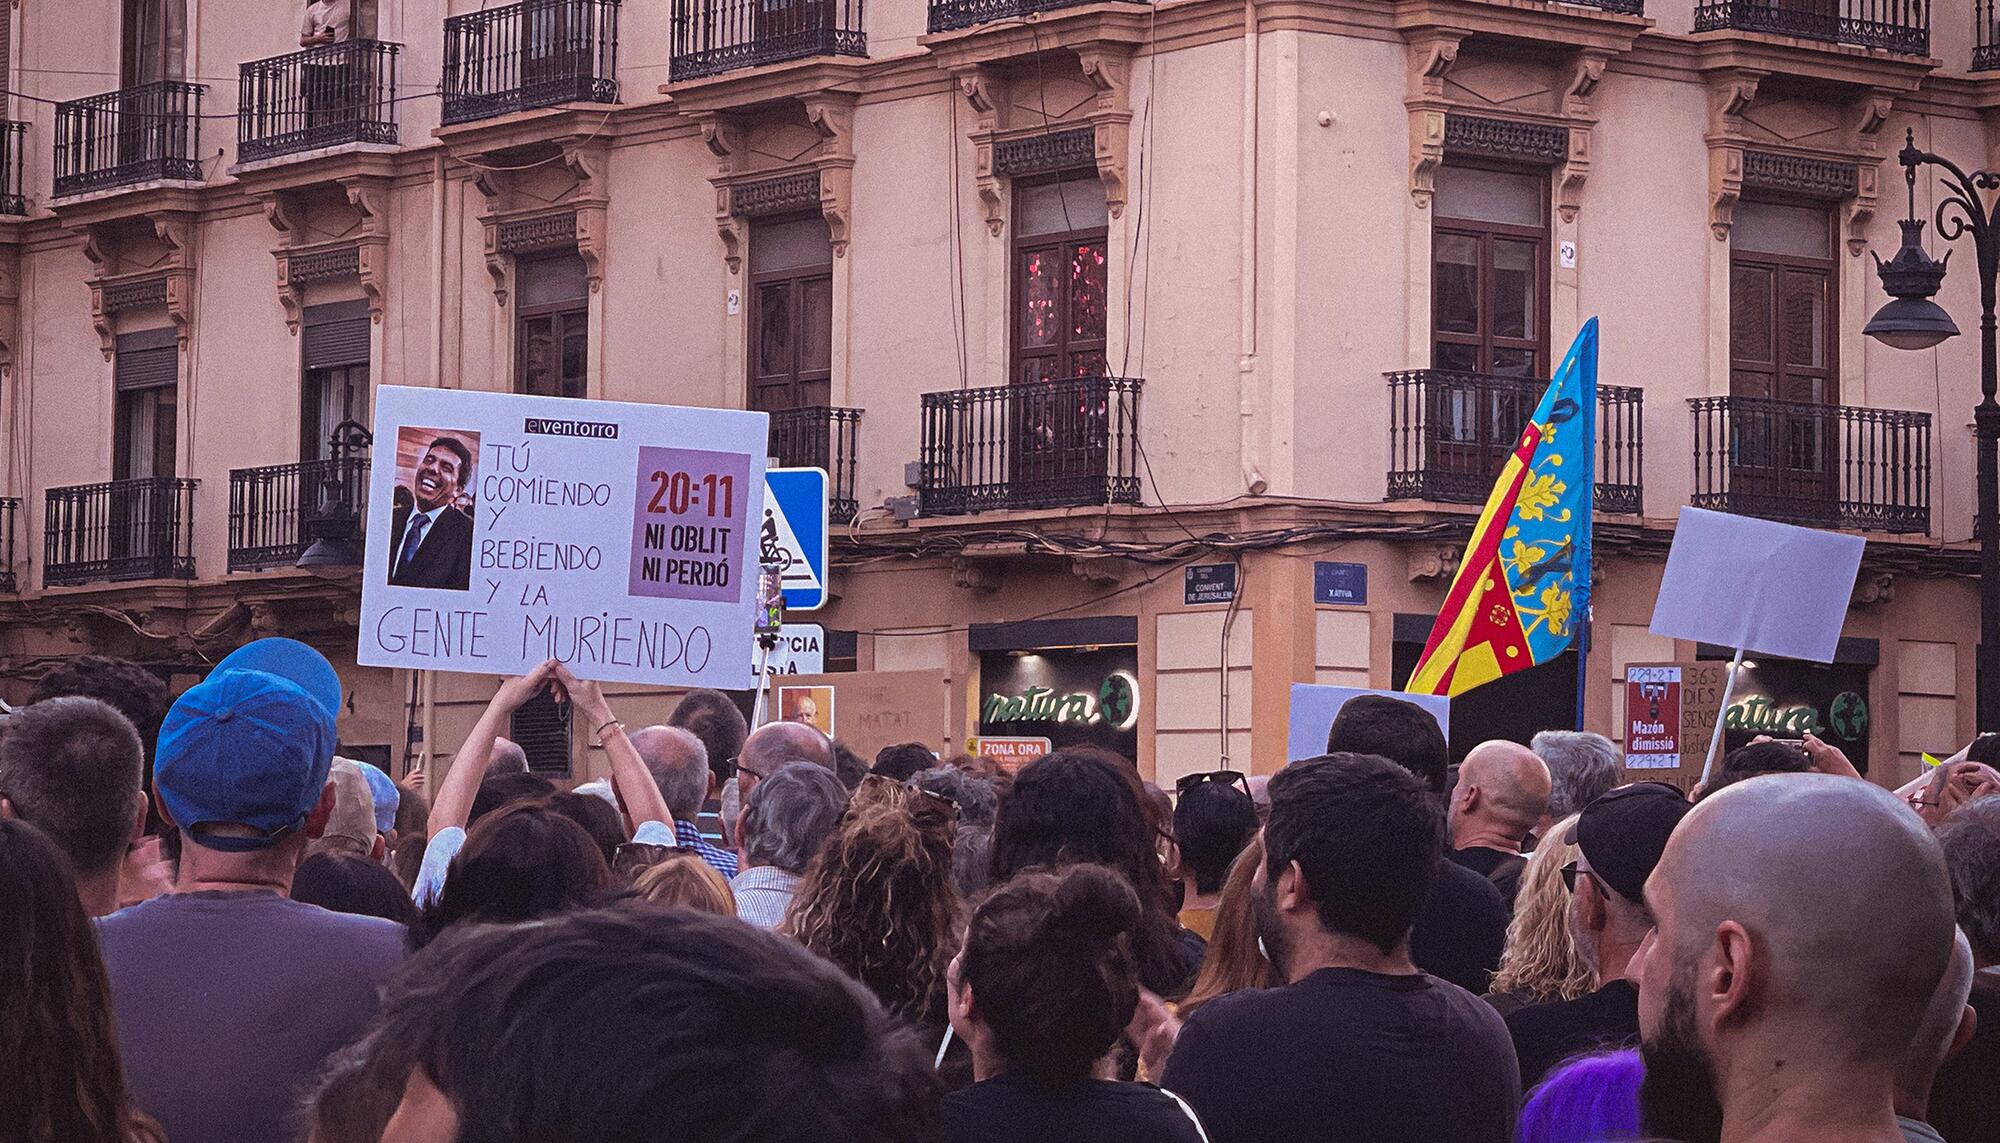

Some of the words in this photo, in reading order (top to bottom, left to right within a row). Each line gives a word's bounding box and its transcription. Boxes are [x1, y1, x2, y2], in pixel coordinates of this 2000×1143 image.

[526, 418, 617, 440] elventorro
[487, 441, 531, 474] TÚ
[647, 470, 734, 519] 20:11
[488, 506, 507, 531] Y
[644, 523, 666, 550] NI
[669, 525, 731, 555] OBLIT
[642, 557, 664, 583] NI
[666, 557, 730, 588] PERDÓ
[486, 579, 503, 604] Y
[520, 583, 549, 607] LA
[1195, 582, 1225, 592] CONVENT
[377, 606, 488, 659] GENTE
[1689, 667, 1719, 686] 365
[983, 685, 1100, 724] natura
[1683, 688, 1716, 705] DIES
[1632, 719, 1665, 735] Mazón
[1682, 710, 1718, 729] SENS
[1725, 695, 1825, 735] atura
[984, 743, 1015, 756] ZONA
[1017, 743, 1042, 756] ORA
[1632, 735, 1674, 751] dimissió
